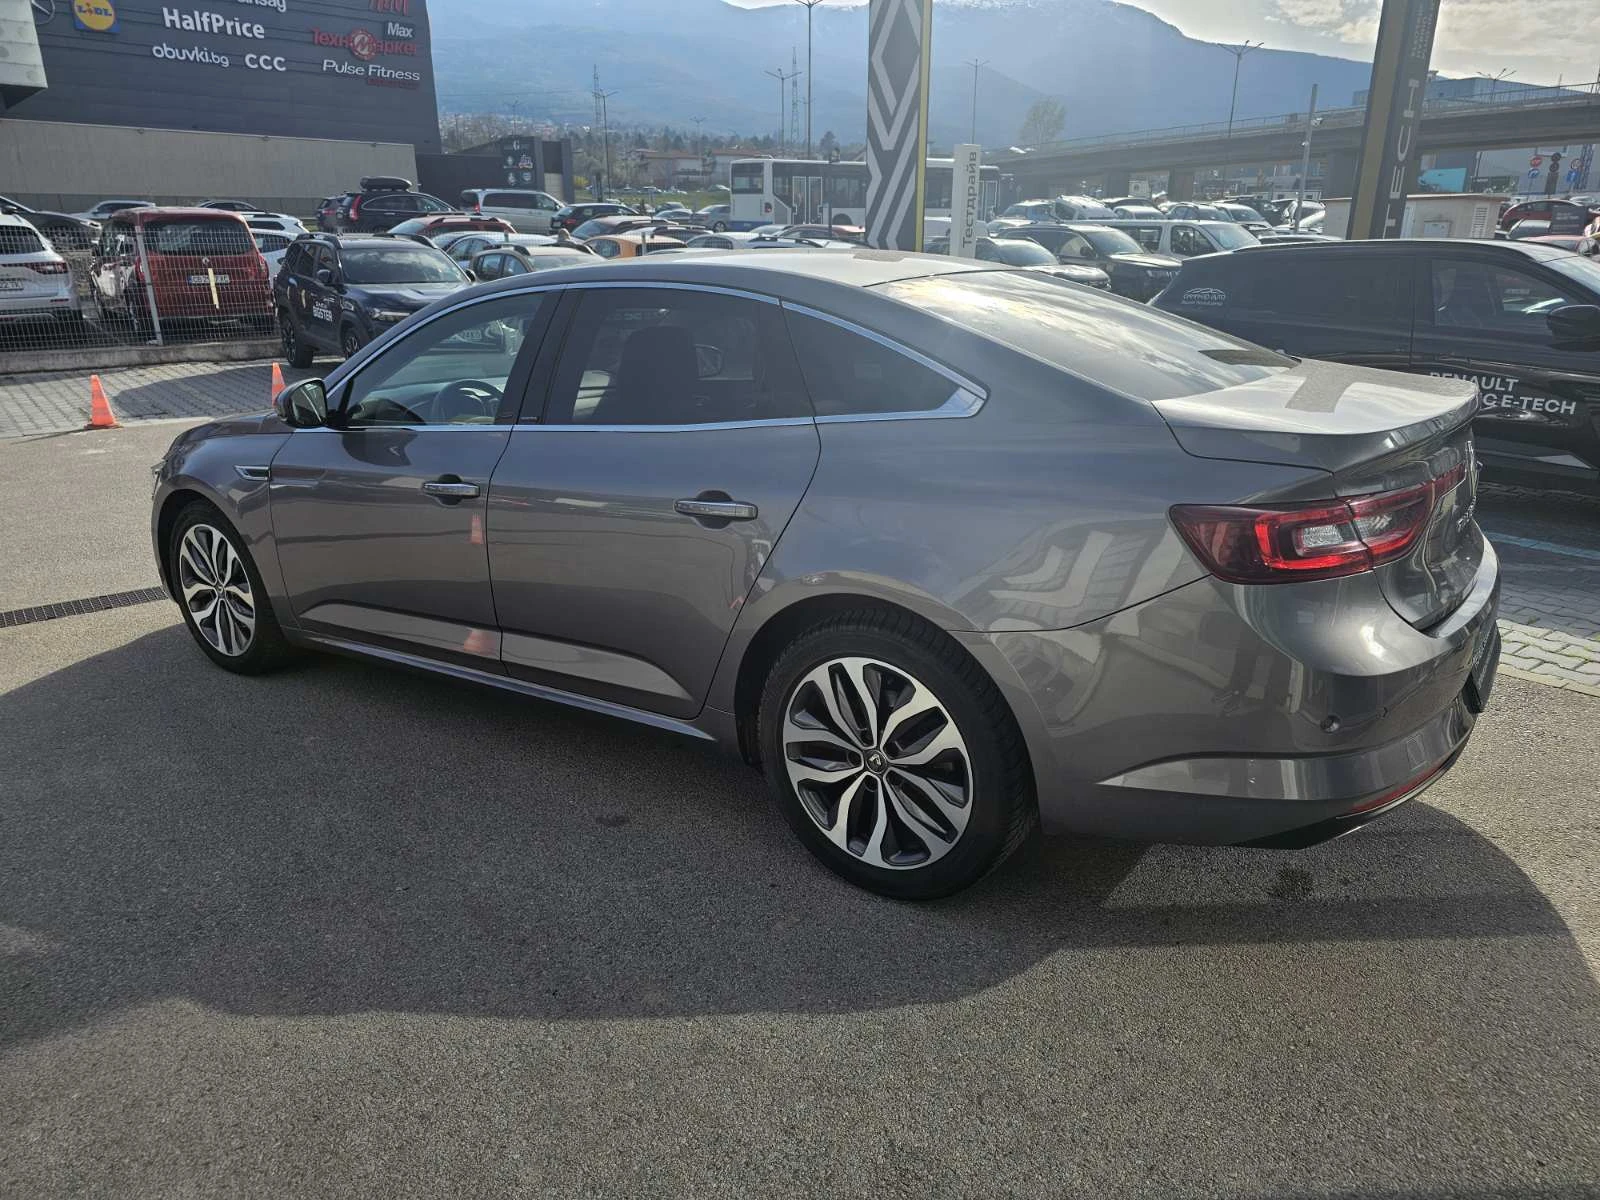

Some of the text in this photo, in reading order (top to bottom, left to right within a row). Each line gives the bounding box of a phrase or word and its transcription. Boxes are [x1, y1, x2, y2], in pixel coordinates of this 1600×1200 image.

[76, 3, 112, 17] LIDL
[162, 6, 265, 39] HalfPrice
[387, 22, 413, 38] Max
[152, 43, 230, 68] obuvki.bg
[244, 53, 287, 72] CCC
[322, 58, 421, 82] Pulse Fitness
[962, 152, 977, 248] Тестдрайв
[1500, 395, 1577, 415] E-TECH
